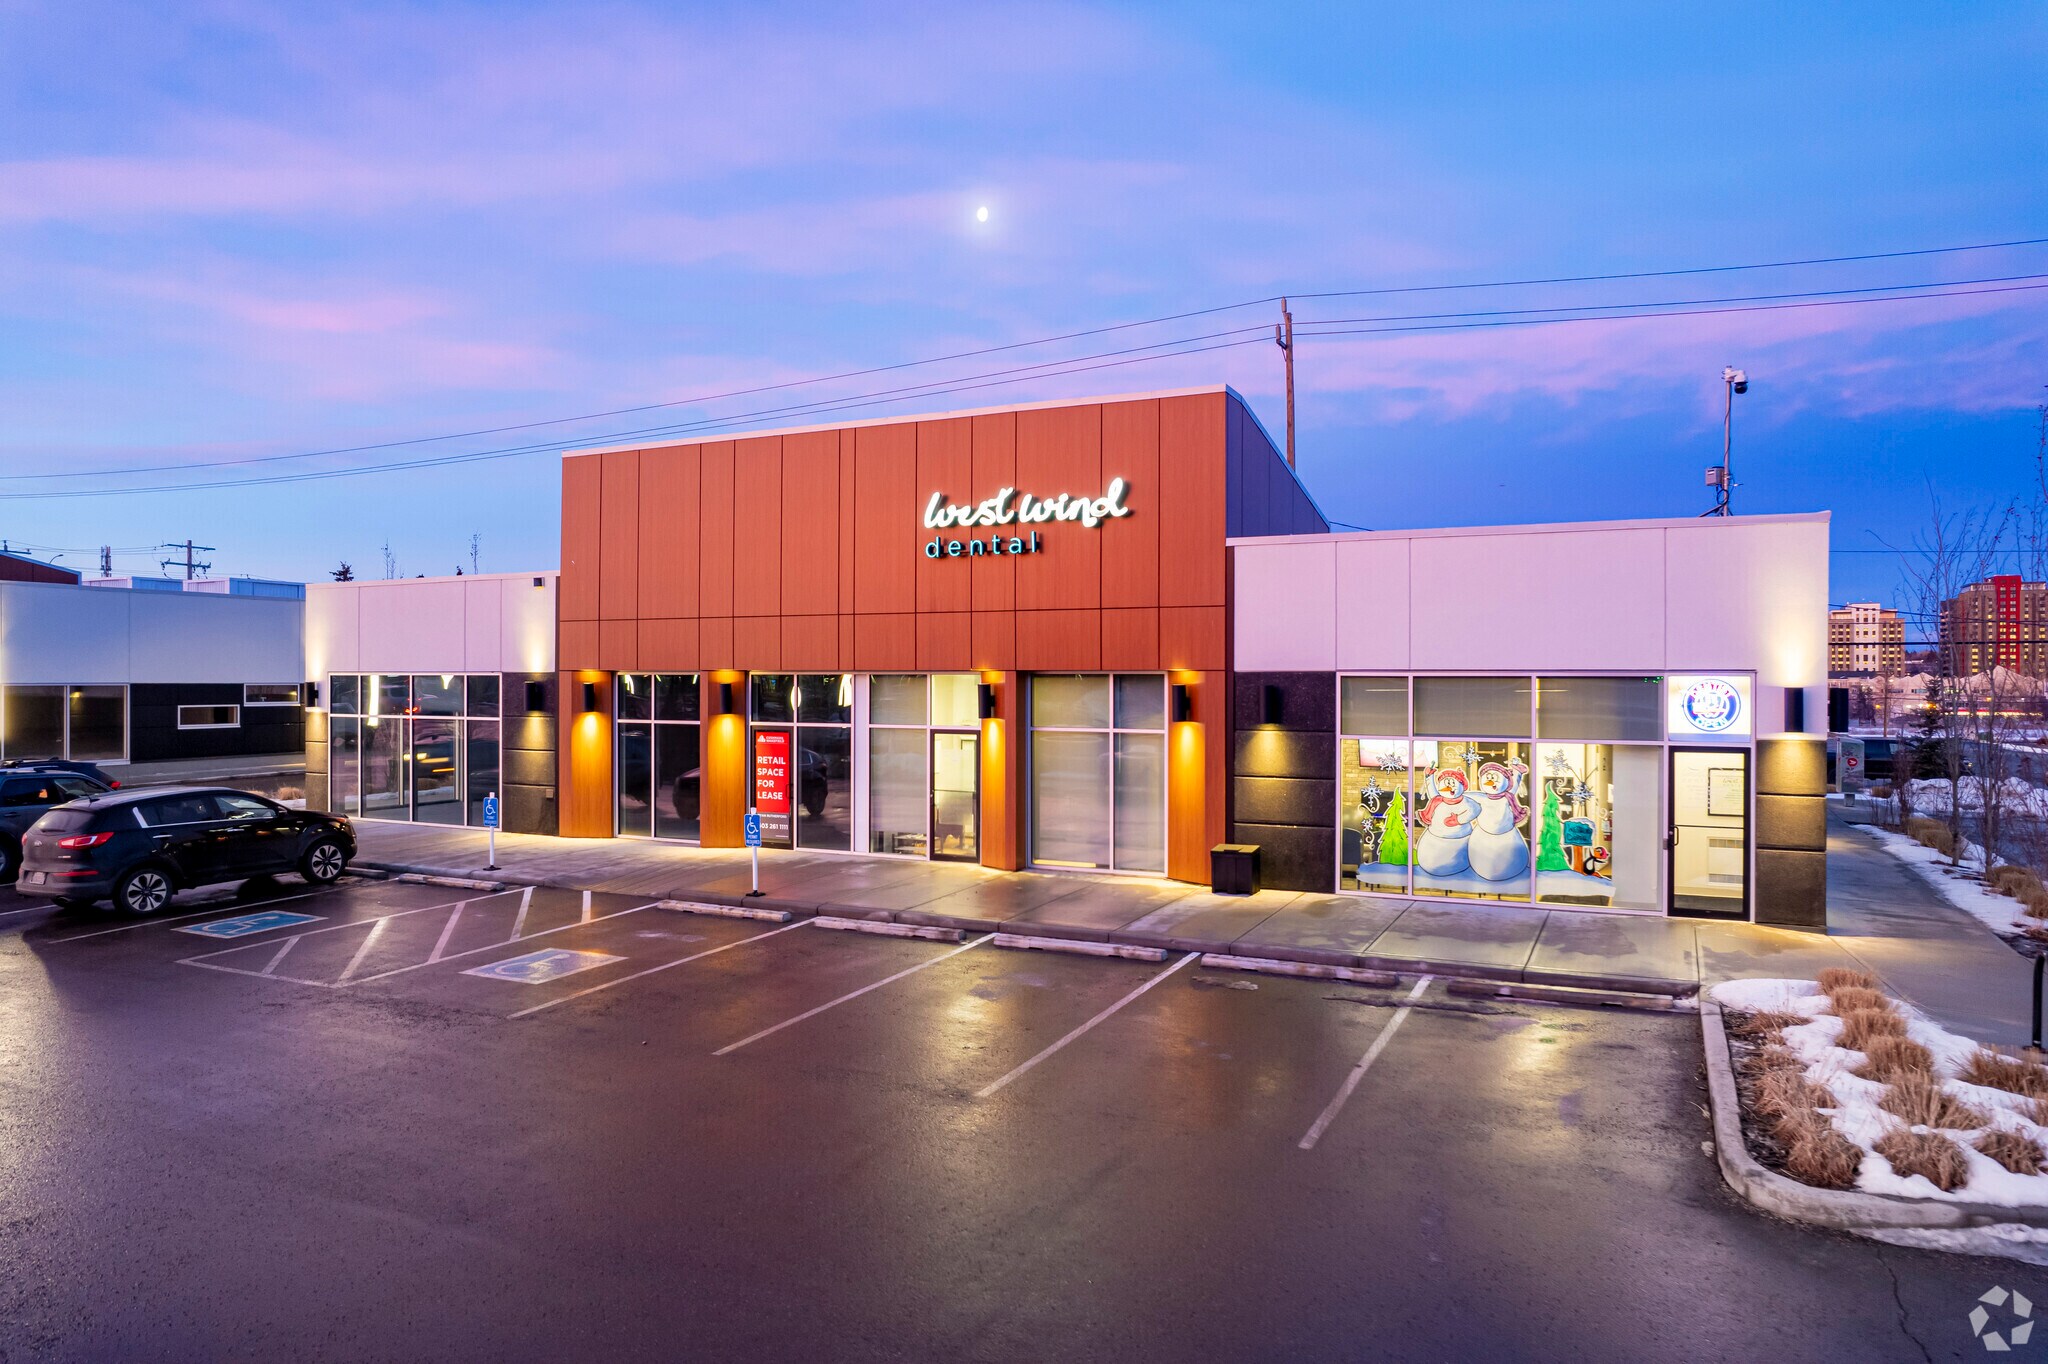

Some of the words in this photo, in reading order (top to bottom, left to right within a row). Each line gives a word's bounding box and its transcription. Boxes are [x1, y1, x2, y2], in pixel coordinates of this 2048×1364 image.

[924, 487, 1014, 528] west
[1018, 477, 1128, 528] wind
[925, 531, 1037, 558] dental
[757, 756, 786, 765] RETAIL
[757, 767, 784, 776] SPACE
[757, 780, 774, 788] FOR
[757, 792, 783, 800] LEASE
